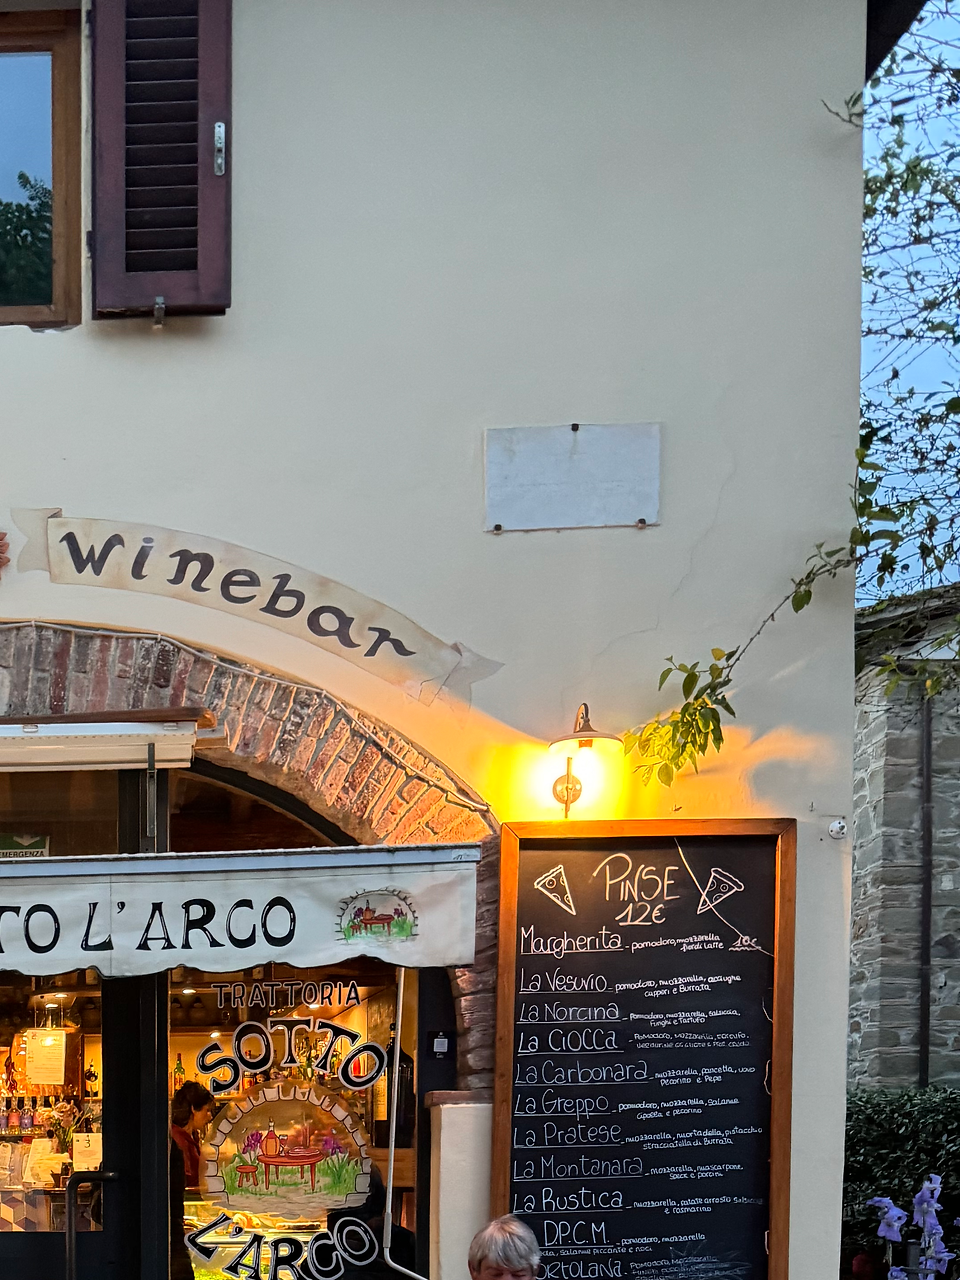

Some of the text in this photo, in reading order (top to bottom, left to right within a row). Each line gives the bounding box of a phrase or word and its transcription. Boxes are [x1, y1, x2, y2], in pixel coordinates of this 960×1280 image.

[81, 895, 296, 951] L'ARCO
[614, 902, 666, 925] 12€
[520, 925, 622, 959] Margherita
[520, 968, 541, 992] La
[545, 967, 608, 992] Vesuvio
[211, 980, 361, 1009] TRATTORIA
[520, 1001, 619, 1022] La Norcina
[196, 1016, 388, 1094] SOTTO
[518, 1032, 539, 1053] La
[515, 1063, 537, 1084] La
[542, 1060, 648, 1084] Carbonara
[515, 1094, 537, 1114] La
[542, 1088, 609, 1121] Greppo
[514, 1127, 536, 1147] La
[543, 1122, 621, 1145] Pratese
[514, 1160, 534, 1179] La
[541, 1154, 642, 1179] Montanara
[513, 1193, 535, 1213] La
[542, 1186, 623, 1211] Rustica
[544, 1220, 610, 1247] D.P.C.M.
